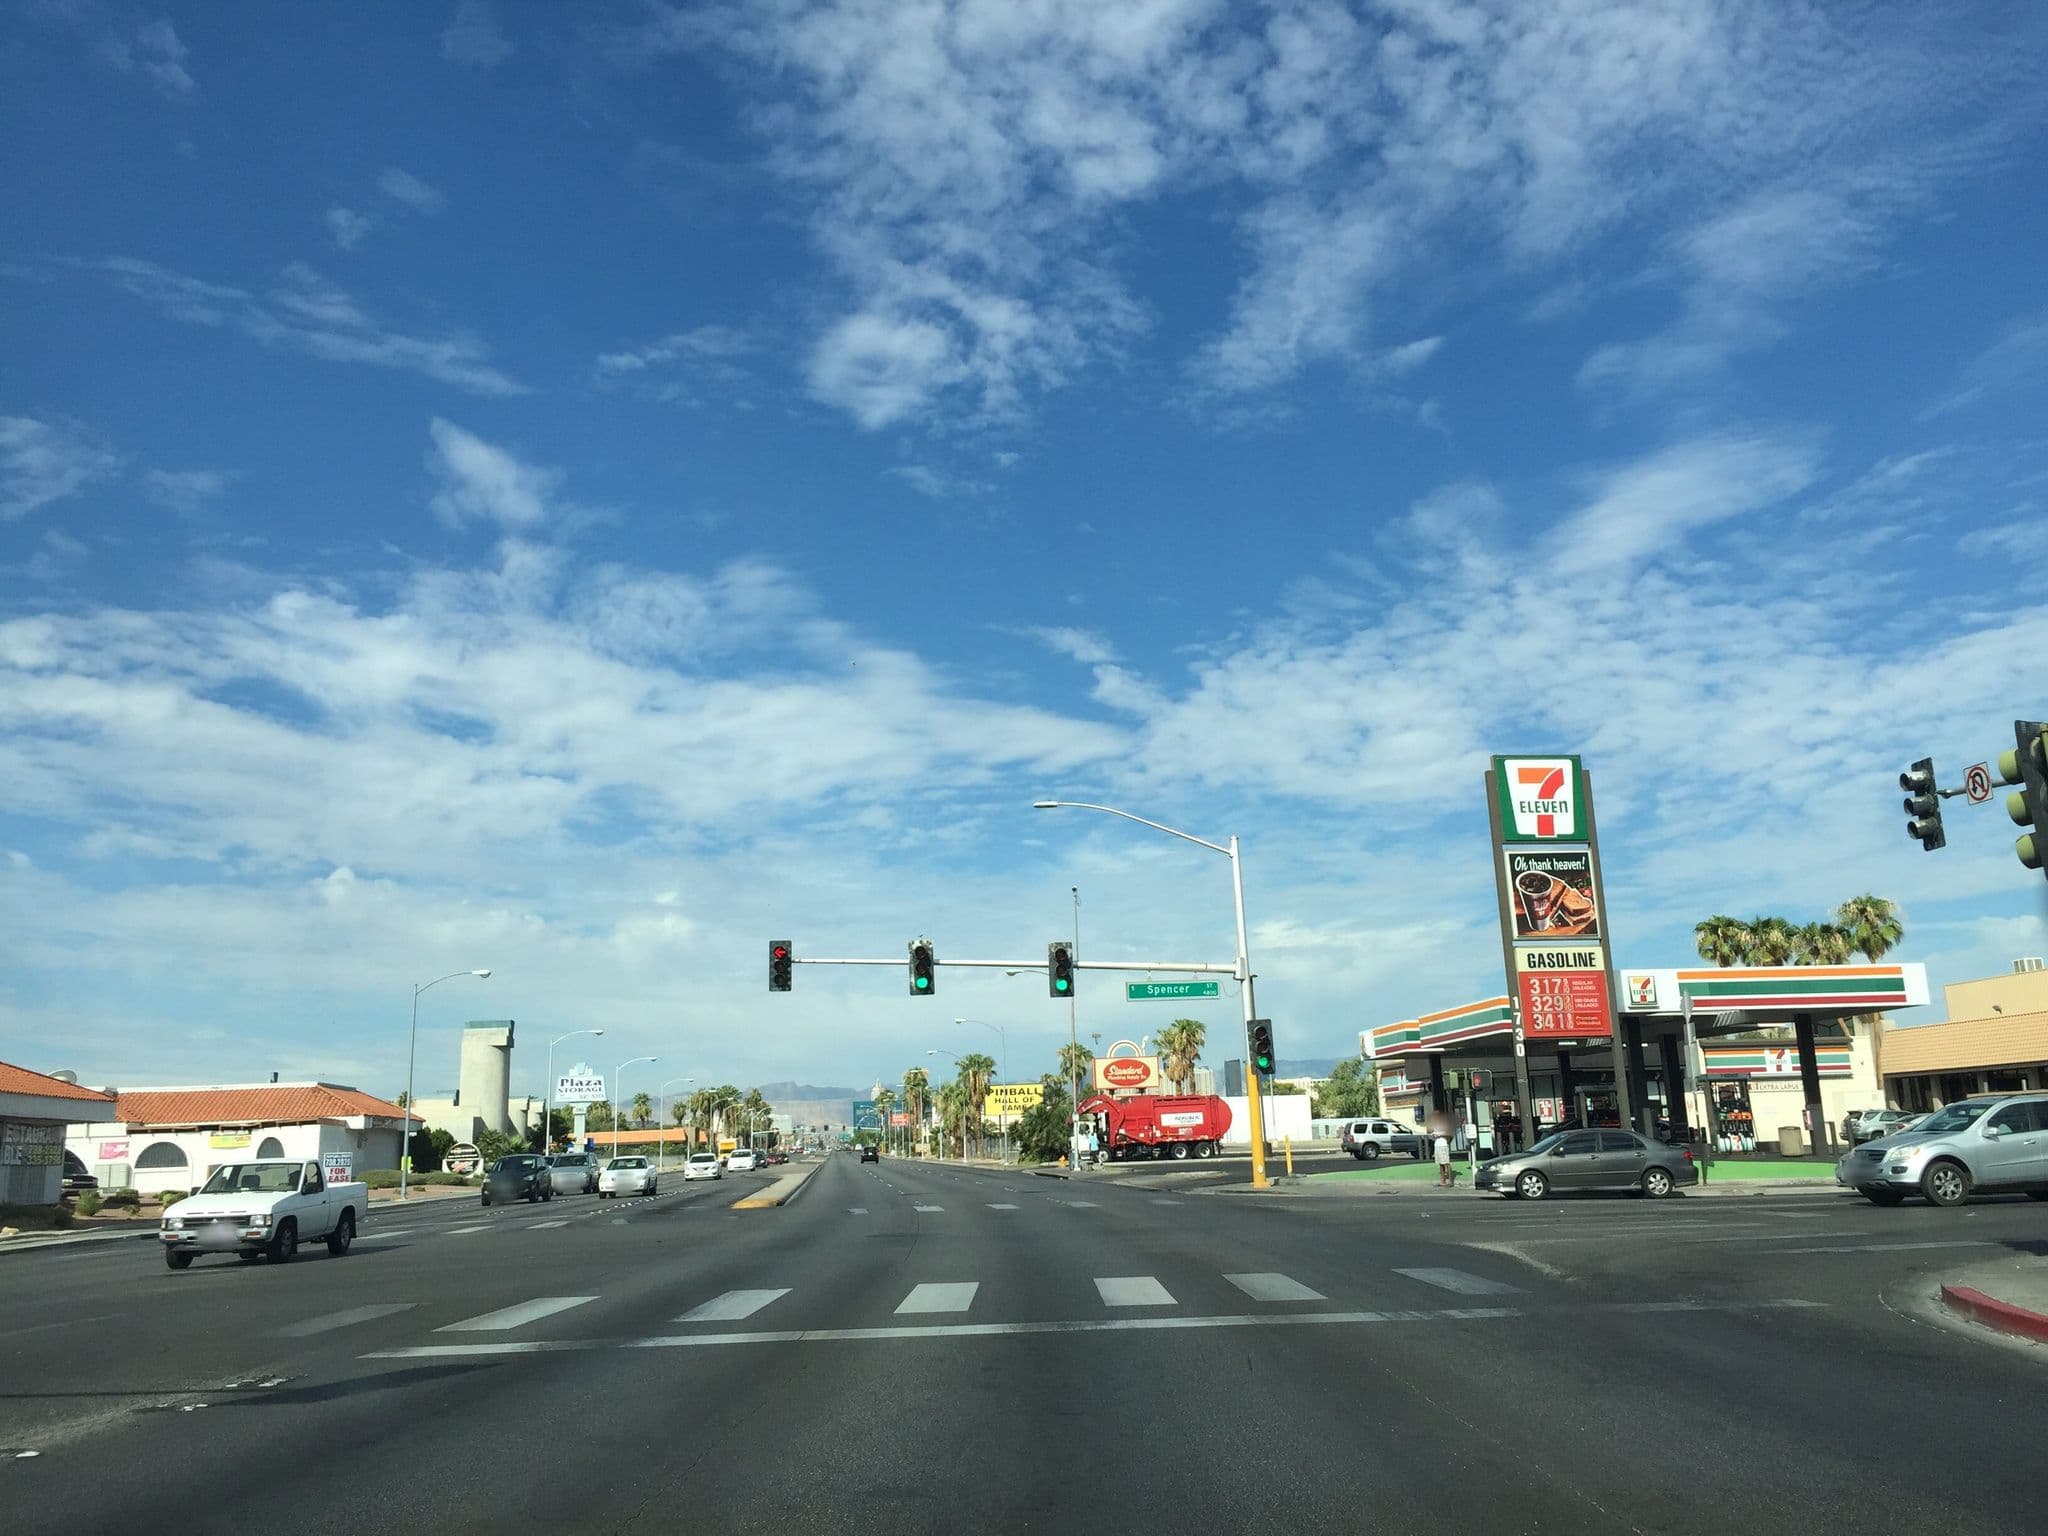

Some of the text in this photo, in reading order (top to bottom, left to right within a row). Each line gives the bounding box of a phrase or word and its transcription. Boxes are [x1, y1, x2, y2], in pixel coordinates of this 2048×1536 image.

[1514, 856, 1586, 871] Oh thank heaven!
[1527, 952, 1597, 969] GASOLINE
[1147, 984, 1190, 996] Spencer
[1529, 978, 1562, 994] 317
[1531, 995, 1564, 1012] 329
[1533, 1013, 1566, 1030] 341
[1107, 1064, 1144, 1076] Standard
[560, 1078, 602, 1087] Plaza
[987, 1087, 1040, 1097] PINBALL
